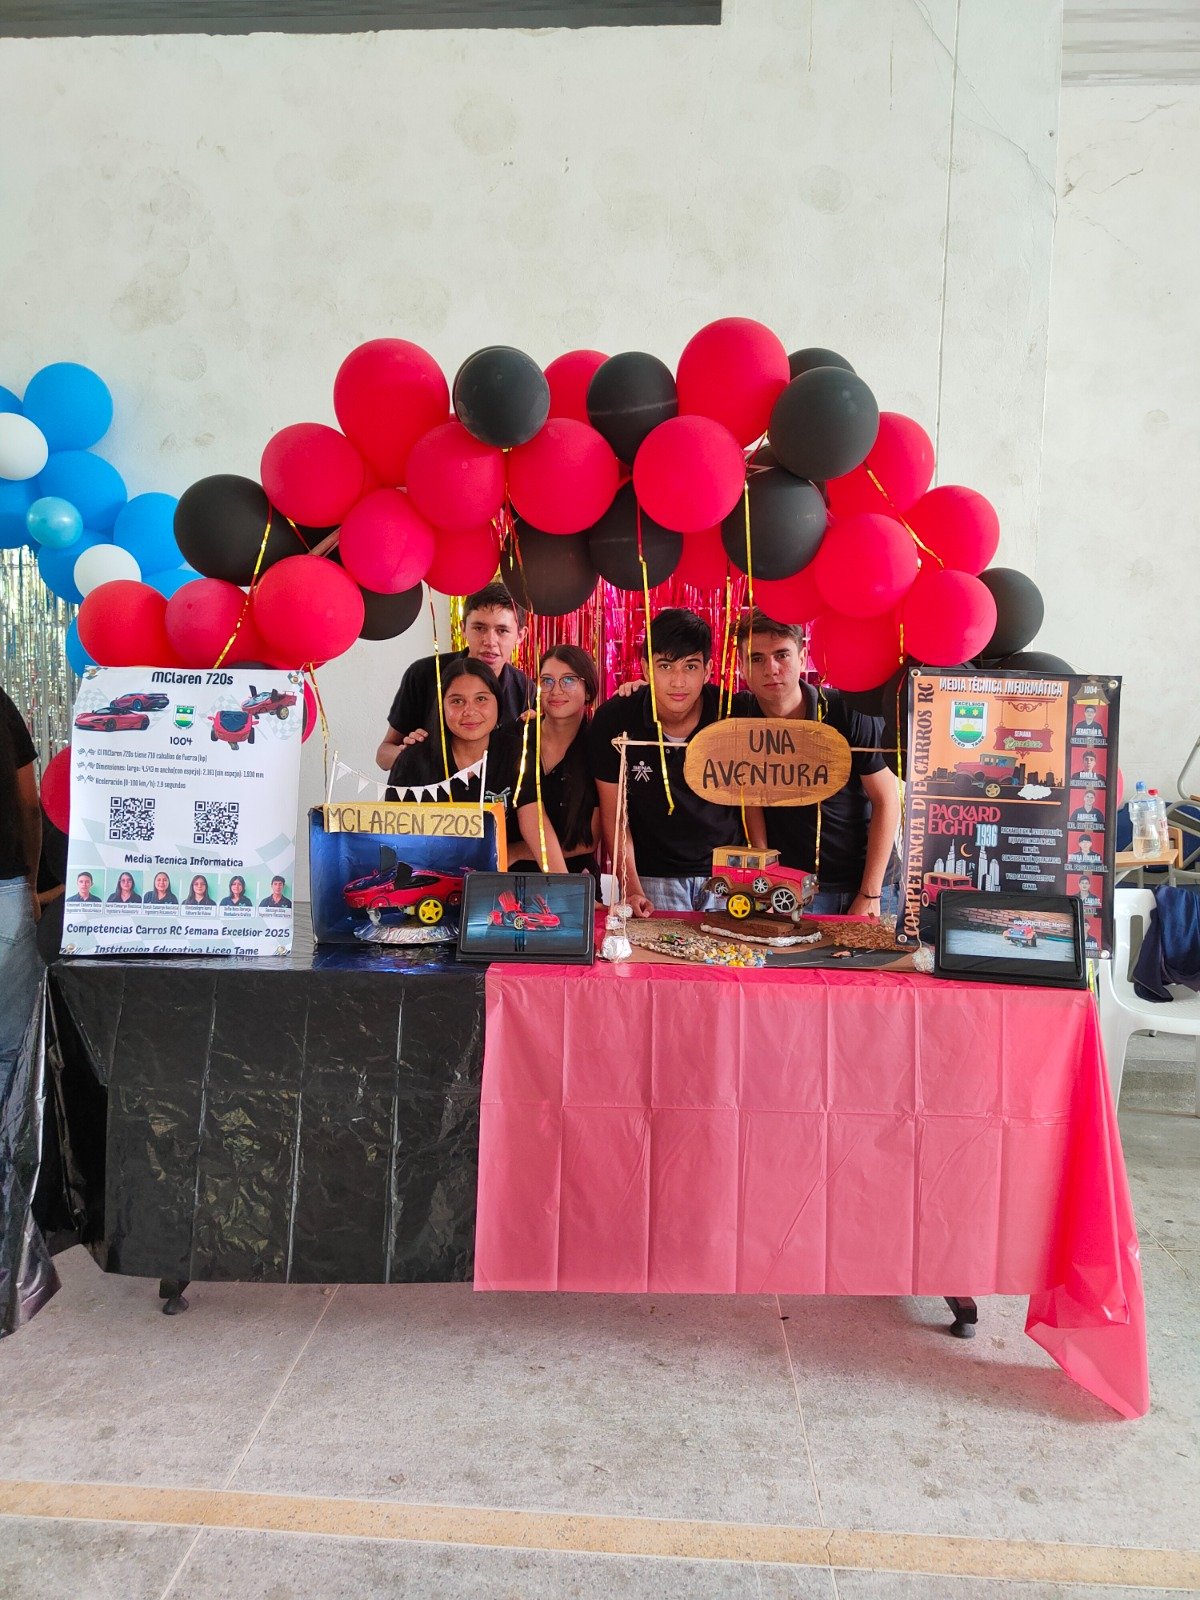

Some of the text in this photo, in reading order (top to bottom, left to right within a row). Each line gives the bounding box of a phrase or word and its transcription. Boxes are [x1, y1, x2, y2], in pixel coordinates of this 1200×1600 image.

[151, 671, 234, 686] MClaren 720s
[940, 676, 1063, 697] MEDIA TÉCNICA INFORMÁTICA
[918, 682, 934, 704] RC
[170, 736, 193, 746] 1004
[749, 728, 796, 754] UNA
[914, 708, 932, 776] CARROS
[702, 758, 828, 788] AVENTURA
[327, 808, 482, 836] MCLAREN 720S
[928, 803, 1002, 822] PACKARD
[928, 818, 978, 836] EIGHT
[974, 823, 998, 847] 1936
[124, 854, 243, 867] Media Tecnica Informatica
[904, 819, 925, 938] COMPETENCIA
[66, 924, 290, 937] Competencias Carros RC Semana Excelsior 2025
[94, 945, 150, 954] Institucion
[234, 946, 259, 955] Tame
